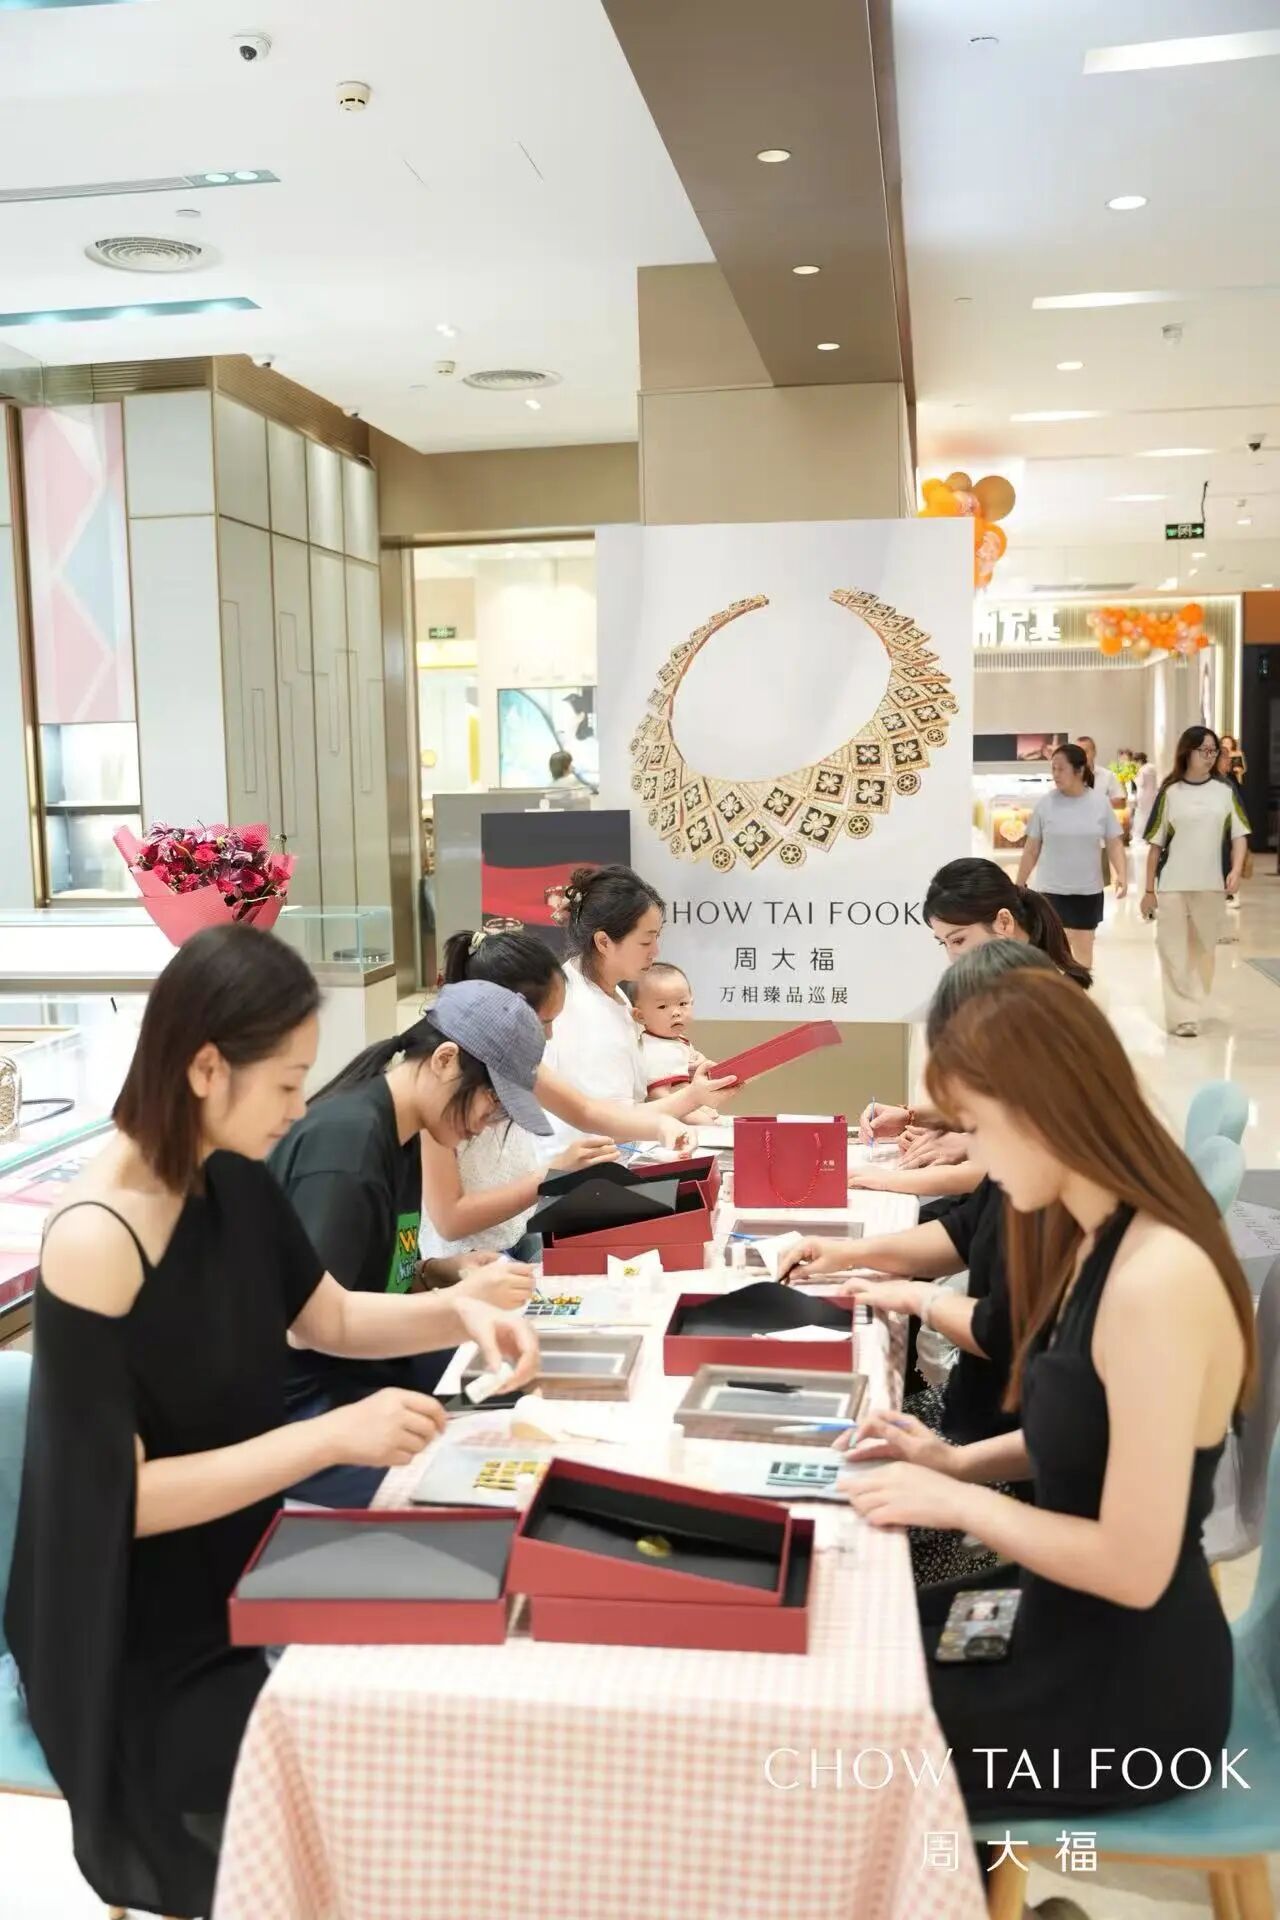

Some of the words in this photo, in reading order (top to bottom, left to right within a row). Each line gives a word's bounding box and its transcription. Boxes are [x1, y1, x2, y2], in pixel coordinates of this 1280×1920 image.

[662, 900, 753, 925] HOW
[763, 901, 813, 925] TAI
[830, 901, 922, 926] FOOK
[734, 947, 834, 972] 周大福
[720, 985, 848, 1005] 万相臻品巡展
